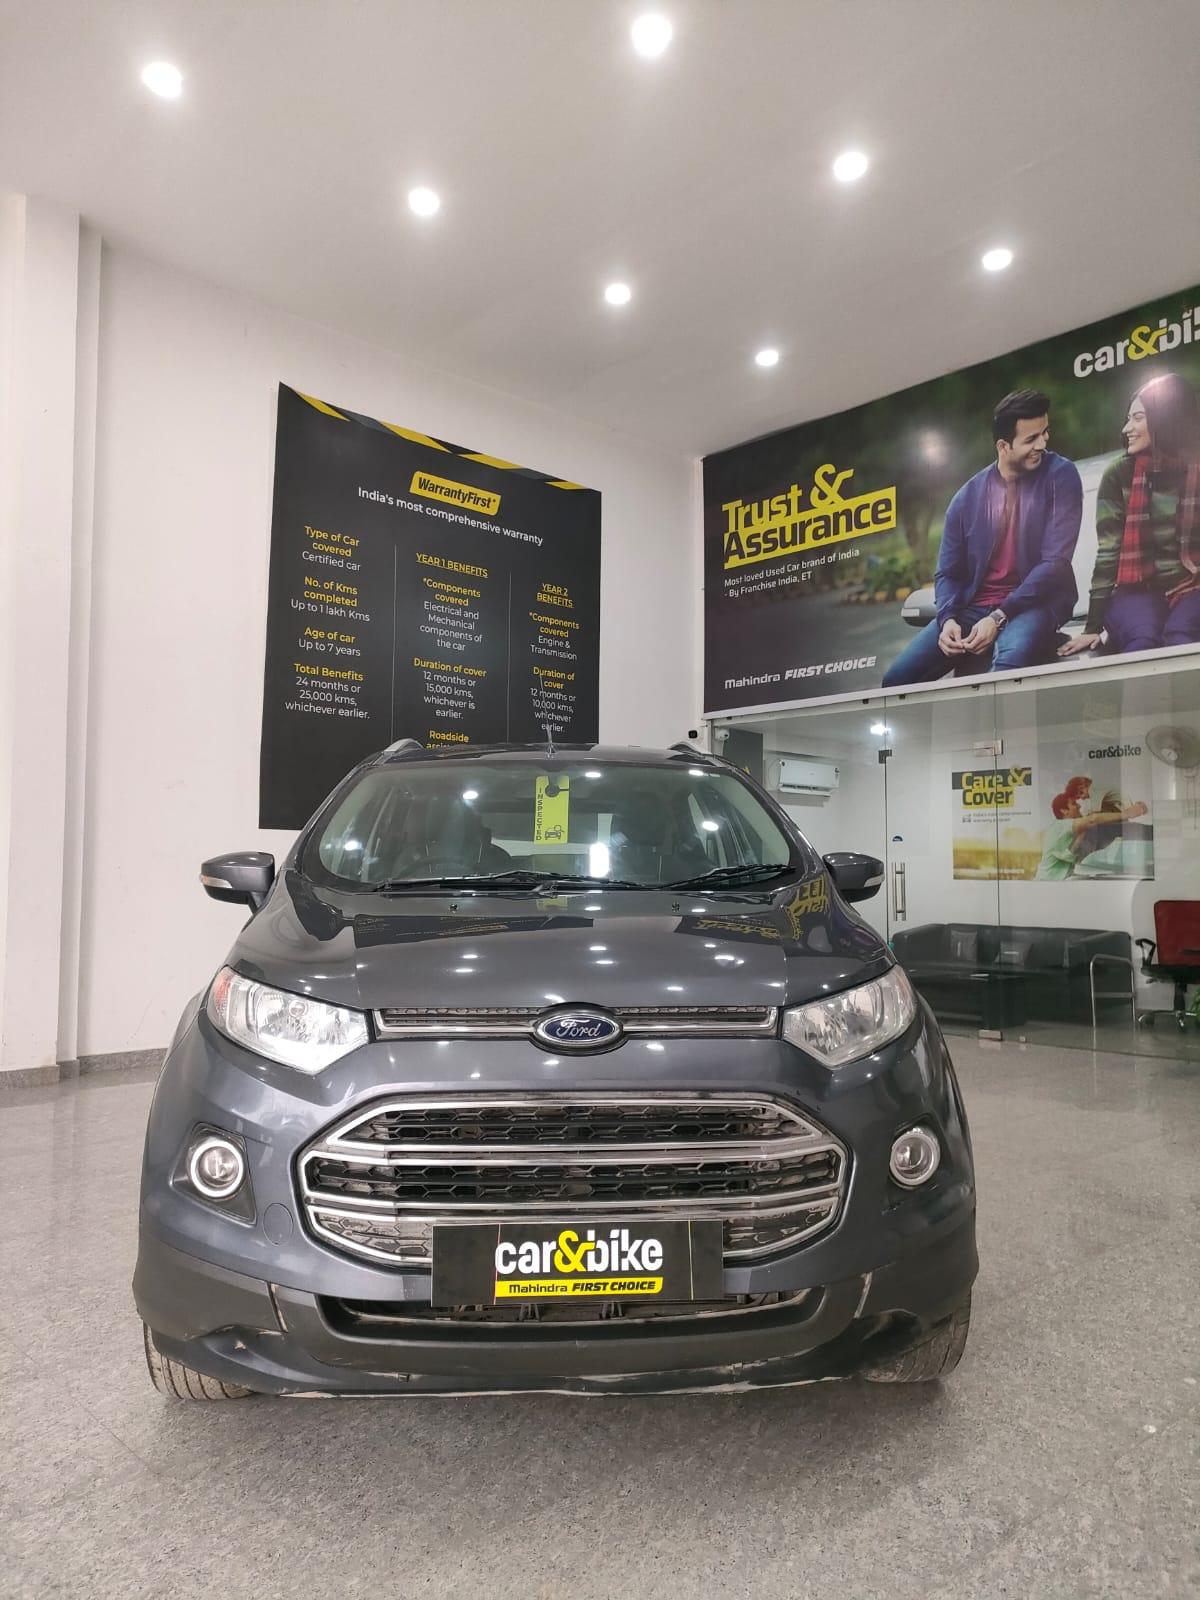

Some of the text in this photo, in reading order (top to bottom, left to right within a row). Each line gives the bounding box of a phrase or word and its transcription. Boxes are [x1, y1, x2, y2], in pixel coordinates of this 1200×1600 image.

[722, 464, 854, 531] Trust &
[358, 487, 543, 546] India's most comprehensive warranty
[304, 526, 328, 539] Type
[343, 536, 360, 546] Car
[725, 498, 891, 561] Assurance
[313, 542, 351, 556] covered
[302, 551, 360, 571] Certified car
[416, 552, 440, 566] YEAR
[448, 561, 488, 578] BENEFITS
[725, 549, 859, 587] Most loved Used Car brand of India
[305, 576, 358, 594] No. of Kms
[543, 583, 568, 596] YEAR 2
[729, 589, 738, 598] By
[741, 580, 776, 595] Franchise
[778, 575, 800, 585] India,
[802, 571, 812, 580] ET
[304, 590, 357, 606] completed
[435, 593, 468, 606] covered
[537, 593, 574, 608] BENEFITS
[291, 599, 370, 621] Up to 1 lakh Kms
[424, 601, 479, 619] Electrical and
[428, 614, 474, 630] Mechanical
[304, 627, 355, 643] Age of car
[420, 625, 482, 642] components of
[540, 627, 568, 637] covered
[299, 638, 360, 656] Up to 7 years
[437, 639, 451, 648] the
[539, 636, 563, 647] Engine
[530, 645, 577, 660] Transmission
[294, 663, 363, 681] Total Benefits
[414, 658, 451, 672] Duration
[464, 668, 487, 677] cover
[534, 667, 565, 679] Duration
[725, 656, 876, 689] Mahindra FIRST CHOICE
[296, 676, 360, 693] 24 months or
[423, 671, 431, 680] 12
[434, 674, 466, 685] months
[544, 681, 564, 689] cover
[300, 690, 357, 706] 25,000 kms,
[426, 683, 473, 698] 15,000 kms,
[531, 688, 537, 696] 12
[540, 691, 567, 700] months
[285, 701, 370, 719] whichever earlier.
[424, 696, 475, 709] whichever is
[436, 709, 463, 719] earlier.
[535, 712, 571, 722] whichever
[430, 730, 469, 742] Roadside
[1088, 744, 1141, 759] car&bike
[962, 765, 1031, 789] Care &
[963, 789, 1013, 805] Cover
[556, 1020, 601, 1037] Ford
[495, 1228, 663, 1274] car&bike
[509, 1281, 655, 1293] Mahindra FIRST CHOICE
